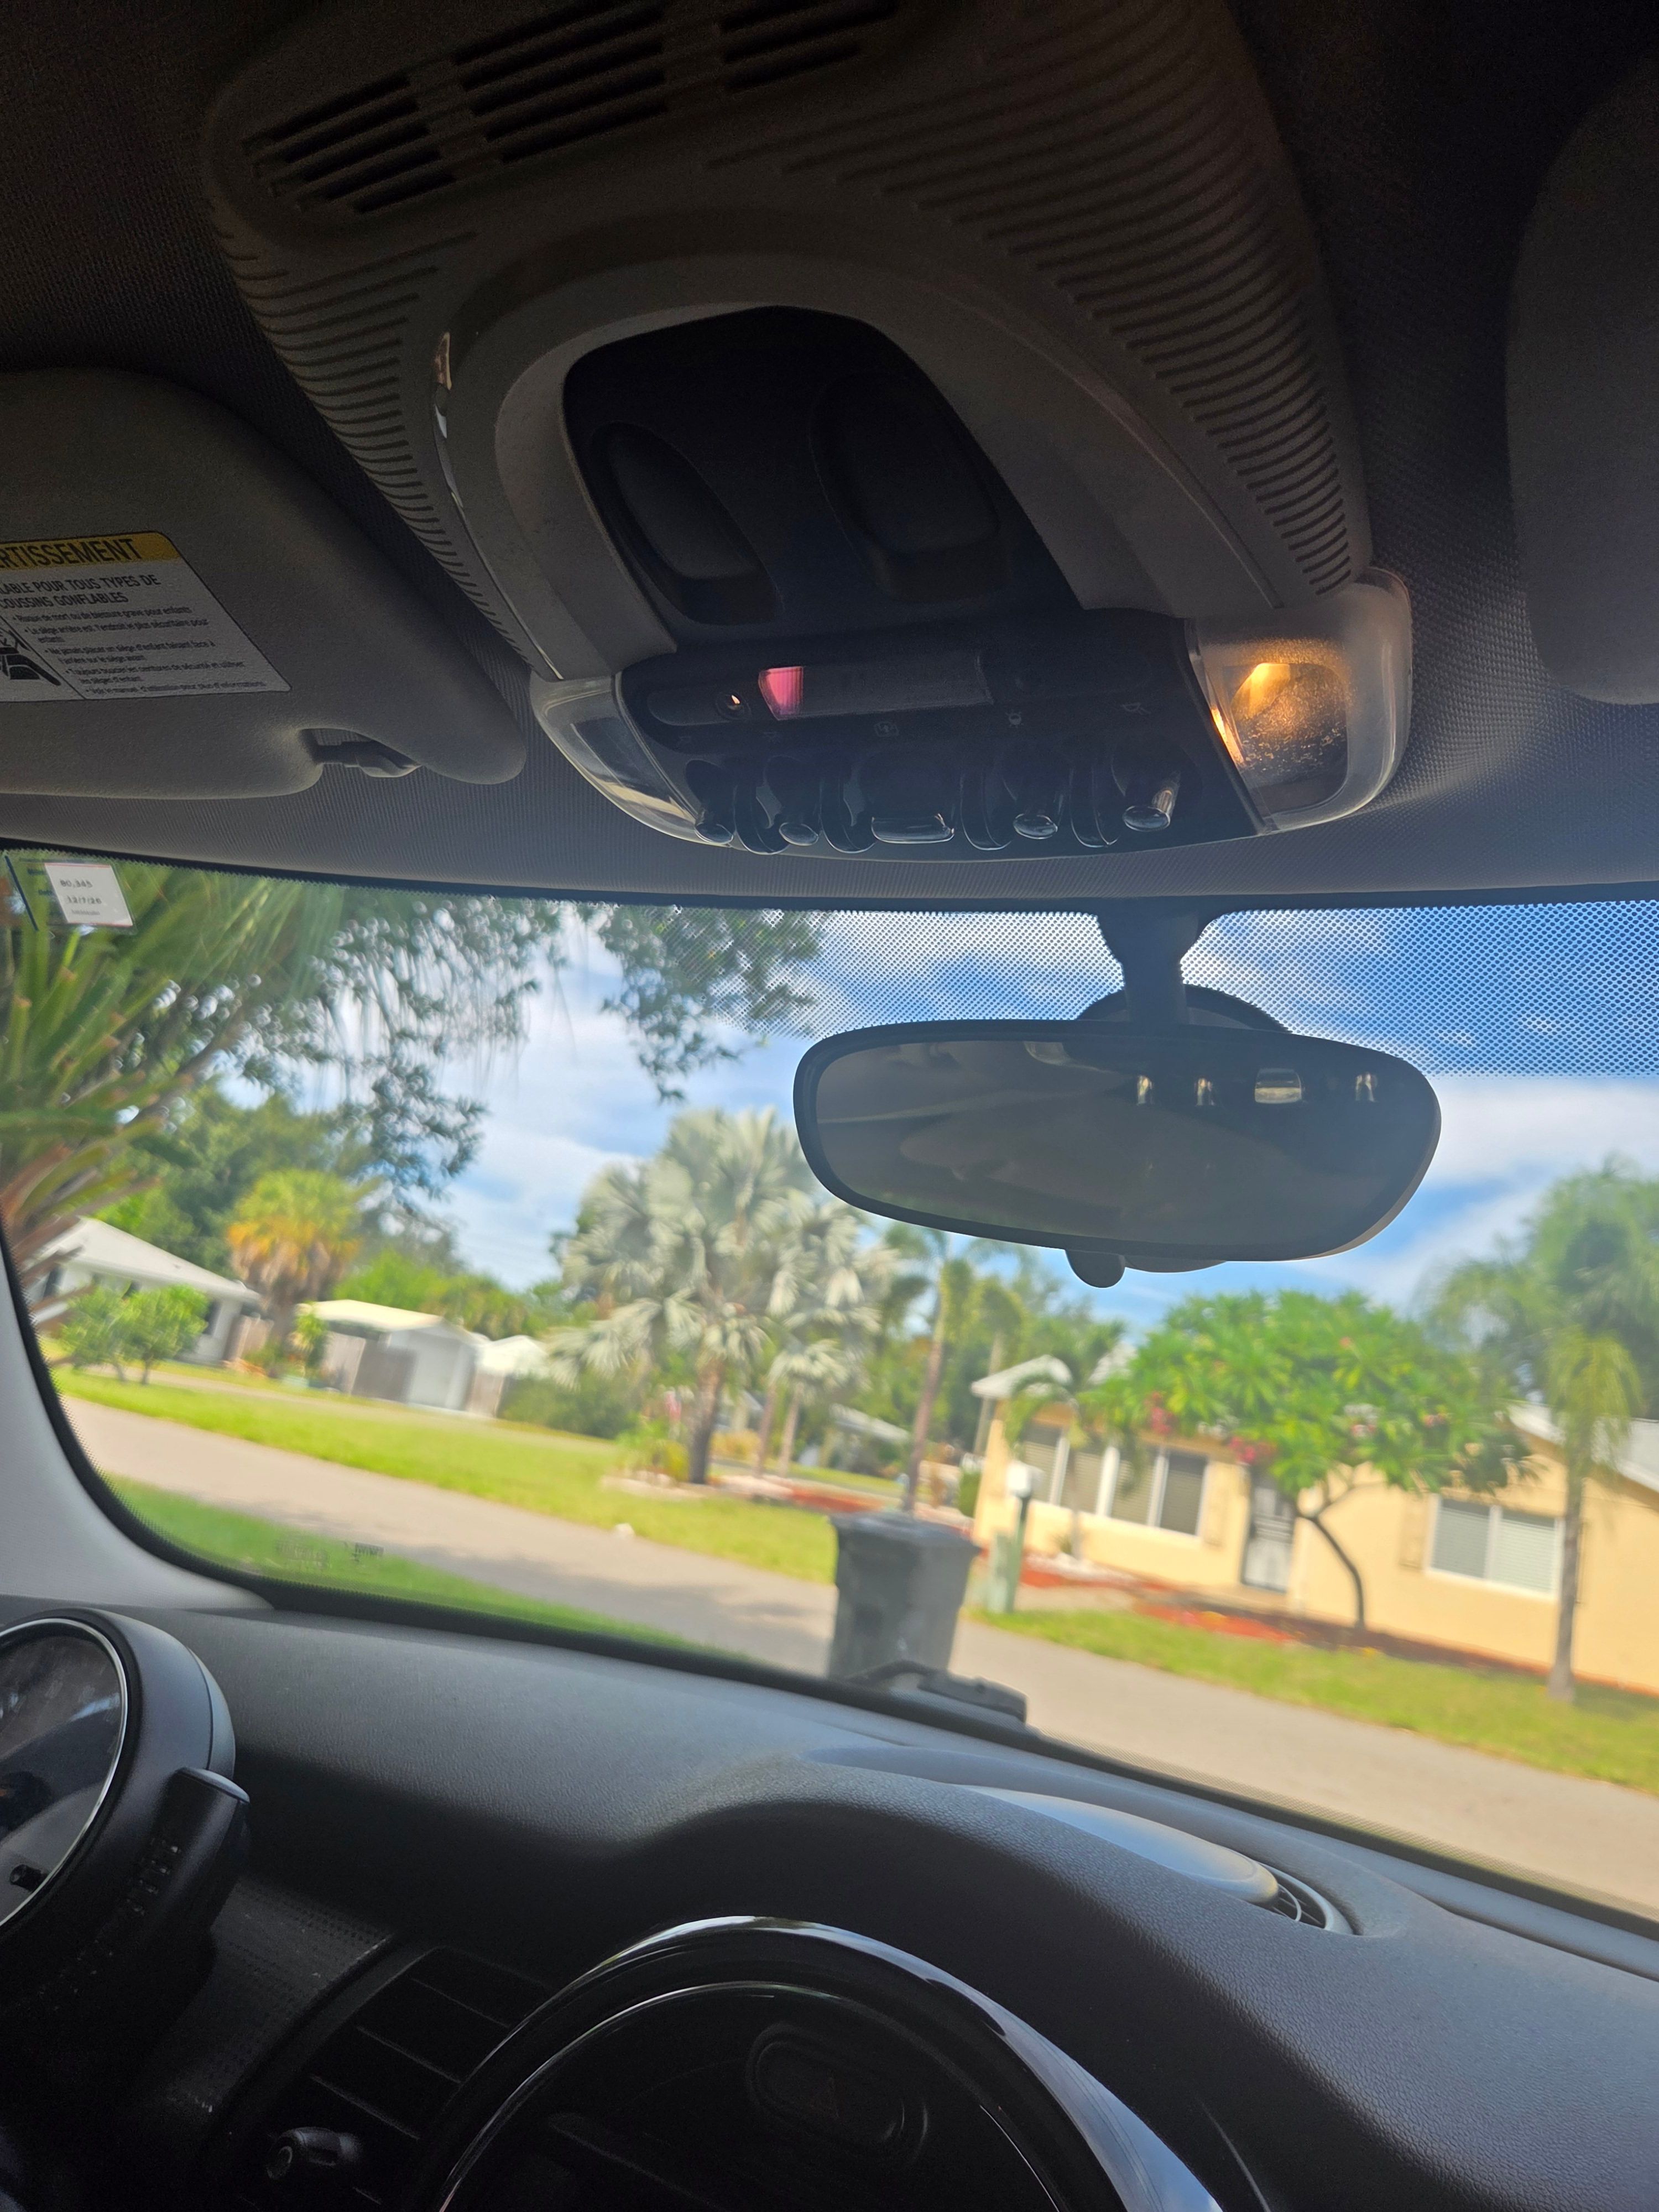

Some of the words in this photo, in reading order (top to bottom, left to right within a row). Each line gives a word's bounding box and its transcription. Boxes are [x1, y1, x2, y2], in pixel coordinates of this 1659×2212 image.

[0, 538, 142, 568] RTISSEMENT
[0, 582, 34, 594] LABLE
[32, 579, 67, 592] POUR
[67, 577, 101, 590] TOUS
[100, 576, 140, 588] TYPES
[139, 574, 161, 586] DE
[53, 591, 129, 606] GONFLABLES
